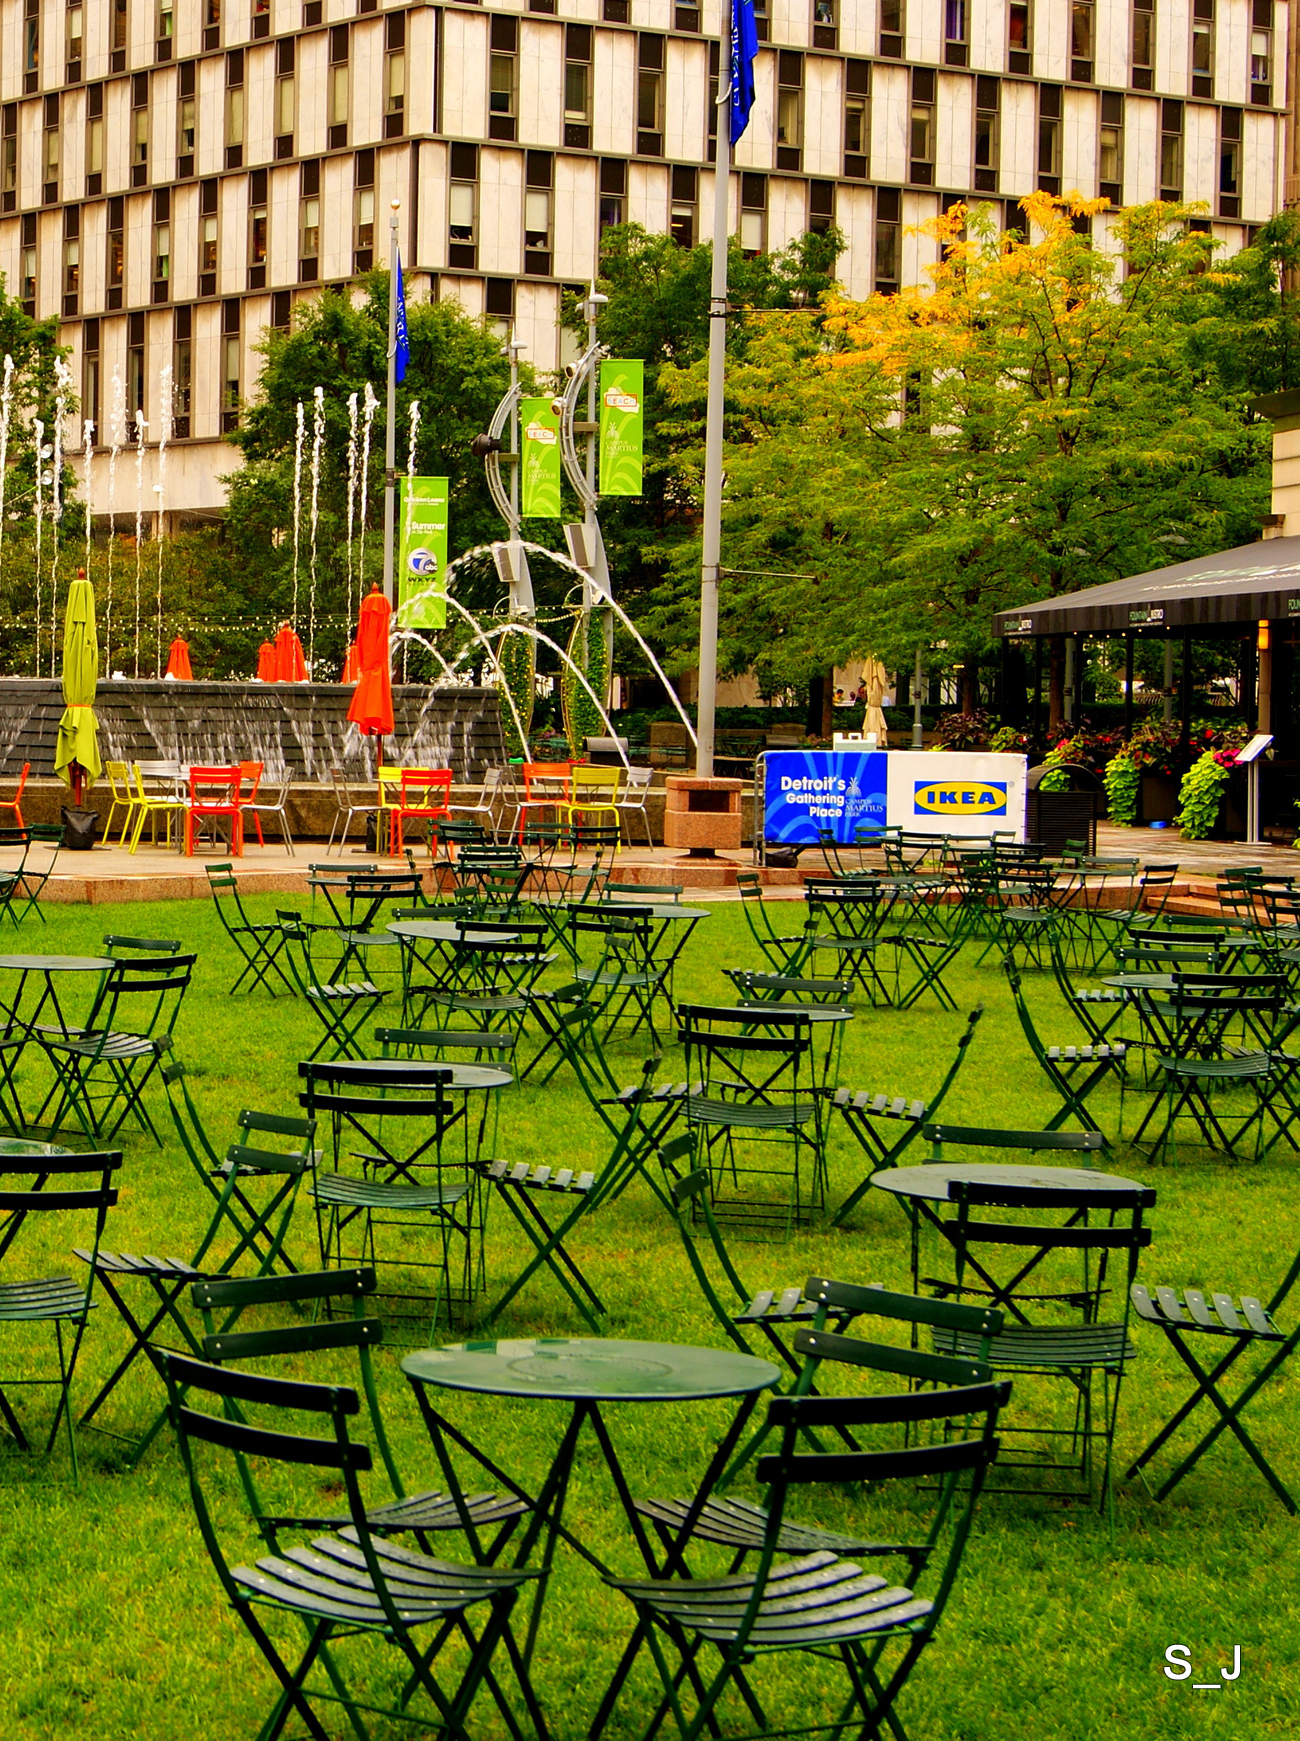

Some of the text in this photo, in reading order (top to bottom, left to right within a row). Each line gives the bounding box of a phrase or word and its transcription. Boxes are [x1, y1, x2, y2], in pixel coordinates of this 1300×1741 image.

[411, 521, 446, 530] Summer
[425, 563, 439, 571] abc
[781, 776, 846, 791] Detroit's
[785, 792, 845, 807] Gathering
[927, 791, 996, 804] IKEA
[809, 806, 843, 817] Place
[845, 804, 884, 812] MARTIUS
